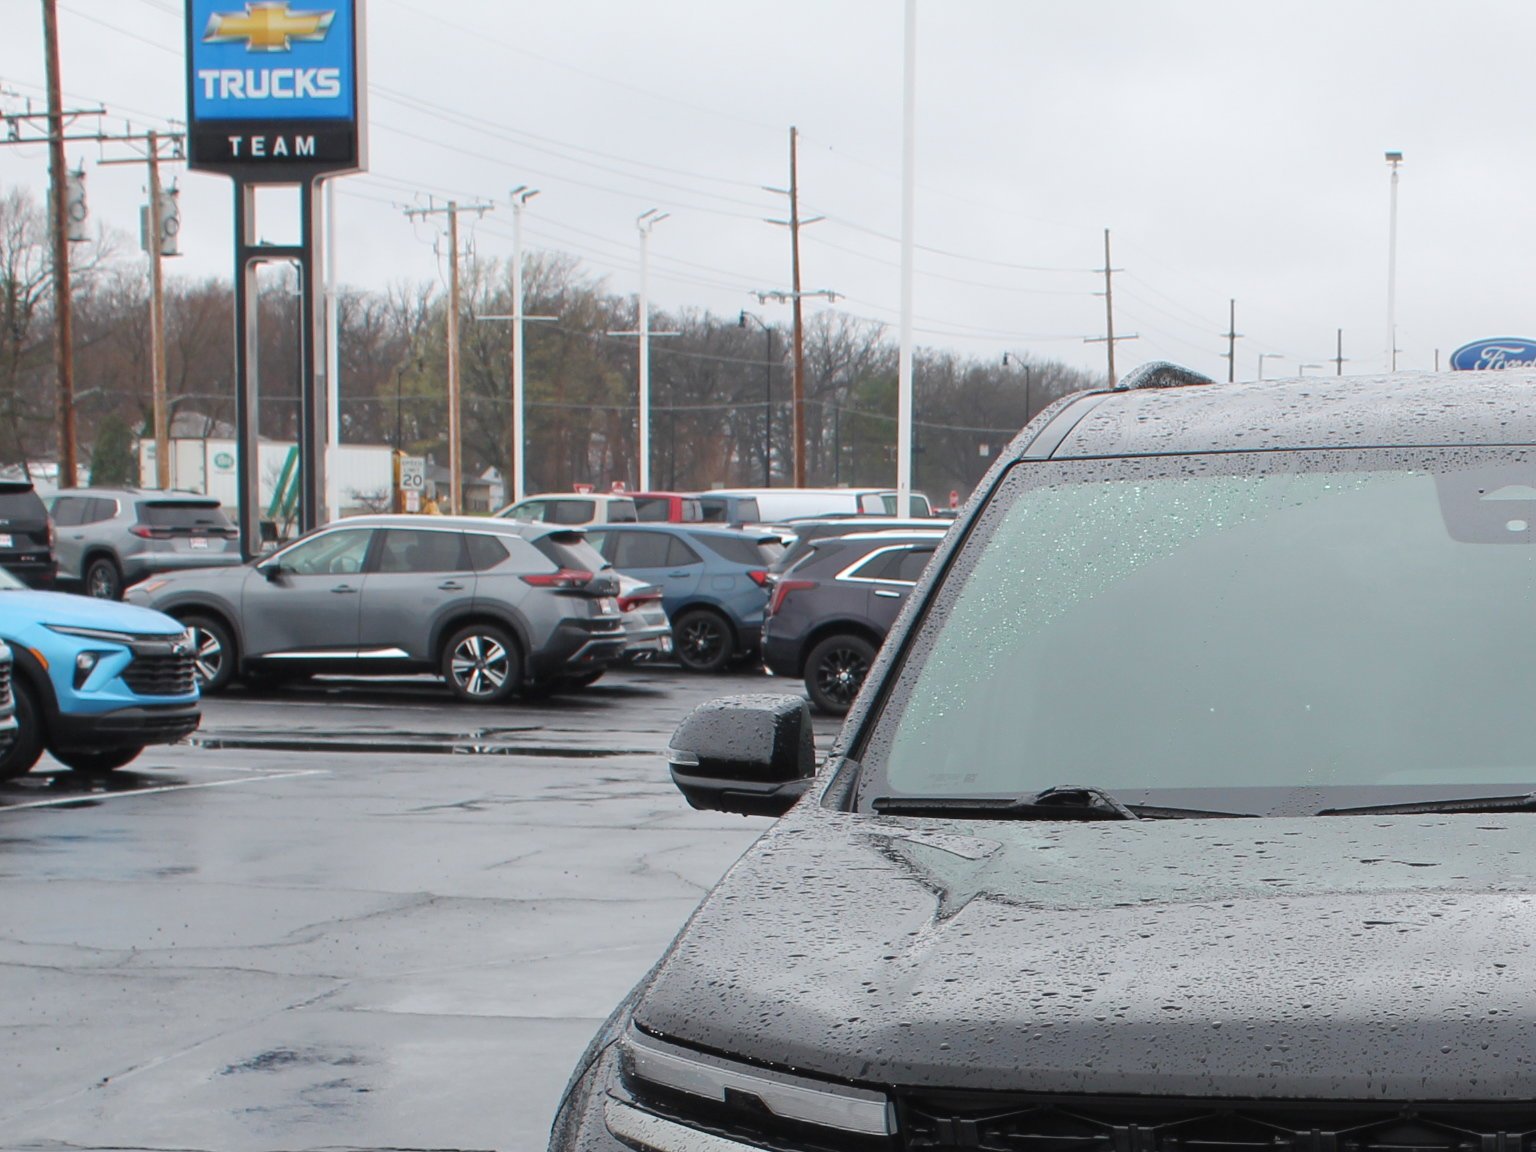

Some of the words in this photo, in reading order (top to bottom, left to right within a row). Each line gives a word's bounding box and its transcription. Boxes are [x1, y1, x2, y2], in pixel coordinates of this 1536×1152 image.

[198, 68, 341, 99] TRUCKS
[228, 135, 315, 157] TEAM
[403, 473, 422, 487] 20
